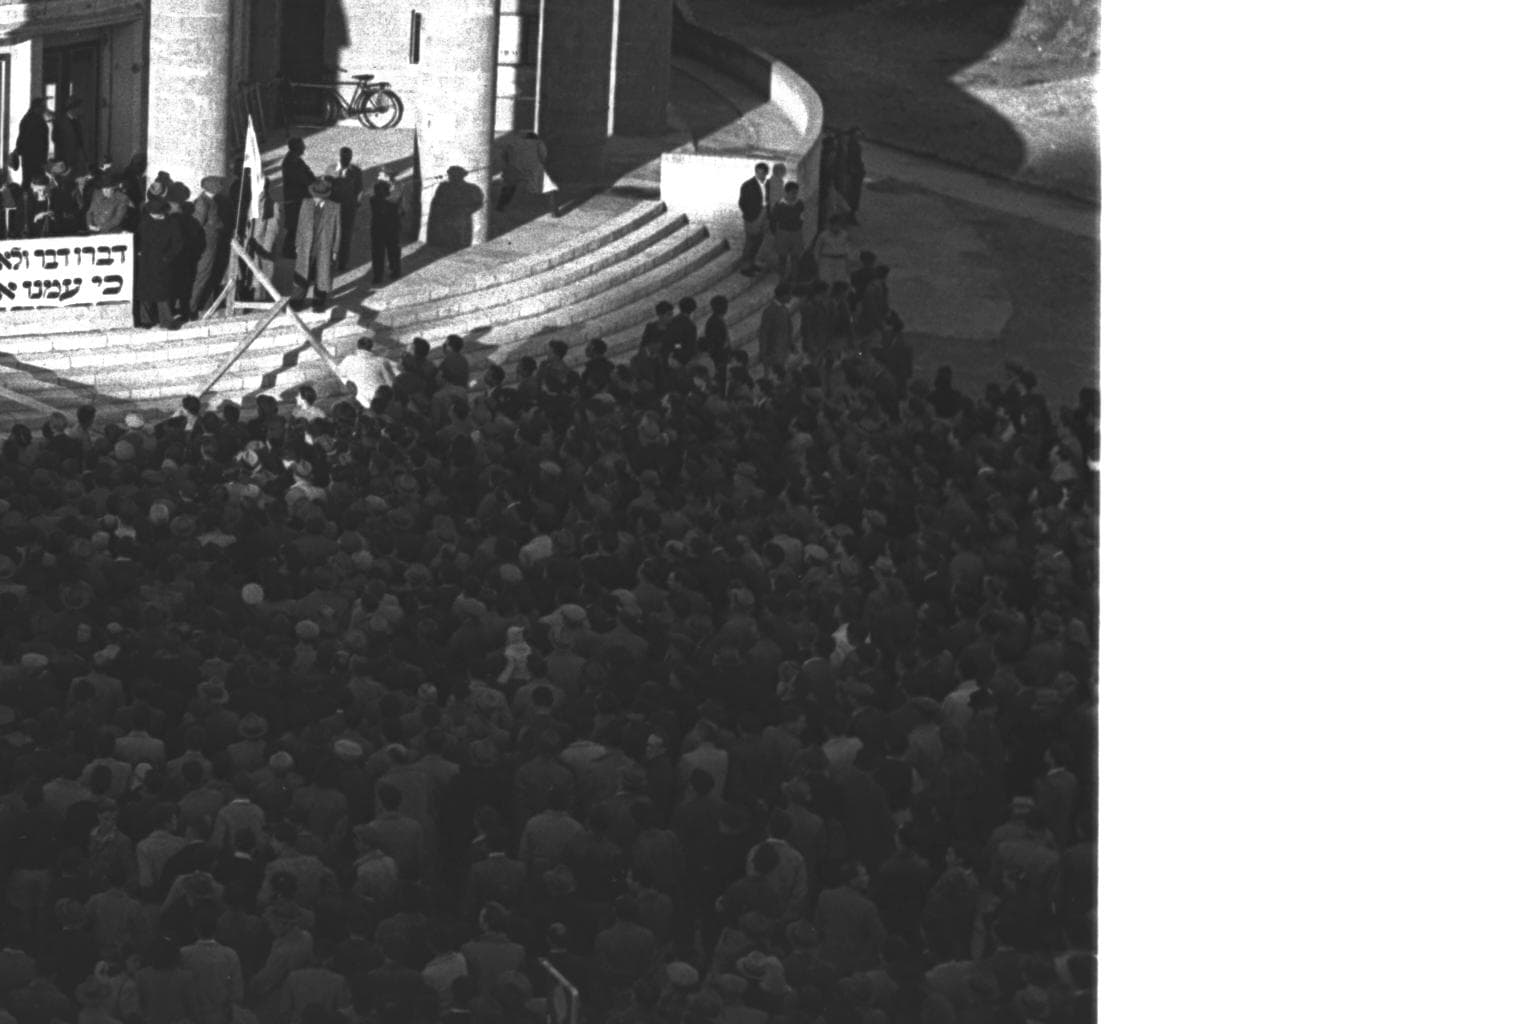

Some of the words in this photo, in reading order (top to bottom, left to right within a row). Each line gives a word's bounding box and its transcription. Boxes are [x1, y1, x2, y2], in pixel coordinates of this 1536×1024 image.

[34, 248, 71, 270] דבר
[74, 245, 128, 266] דברו
[22, 277, 83, 302] עמנו
[91, 274, 124, 295] כי
